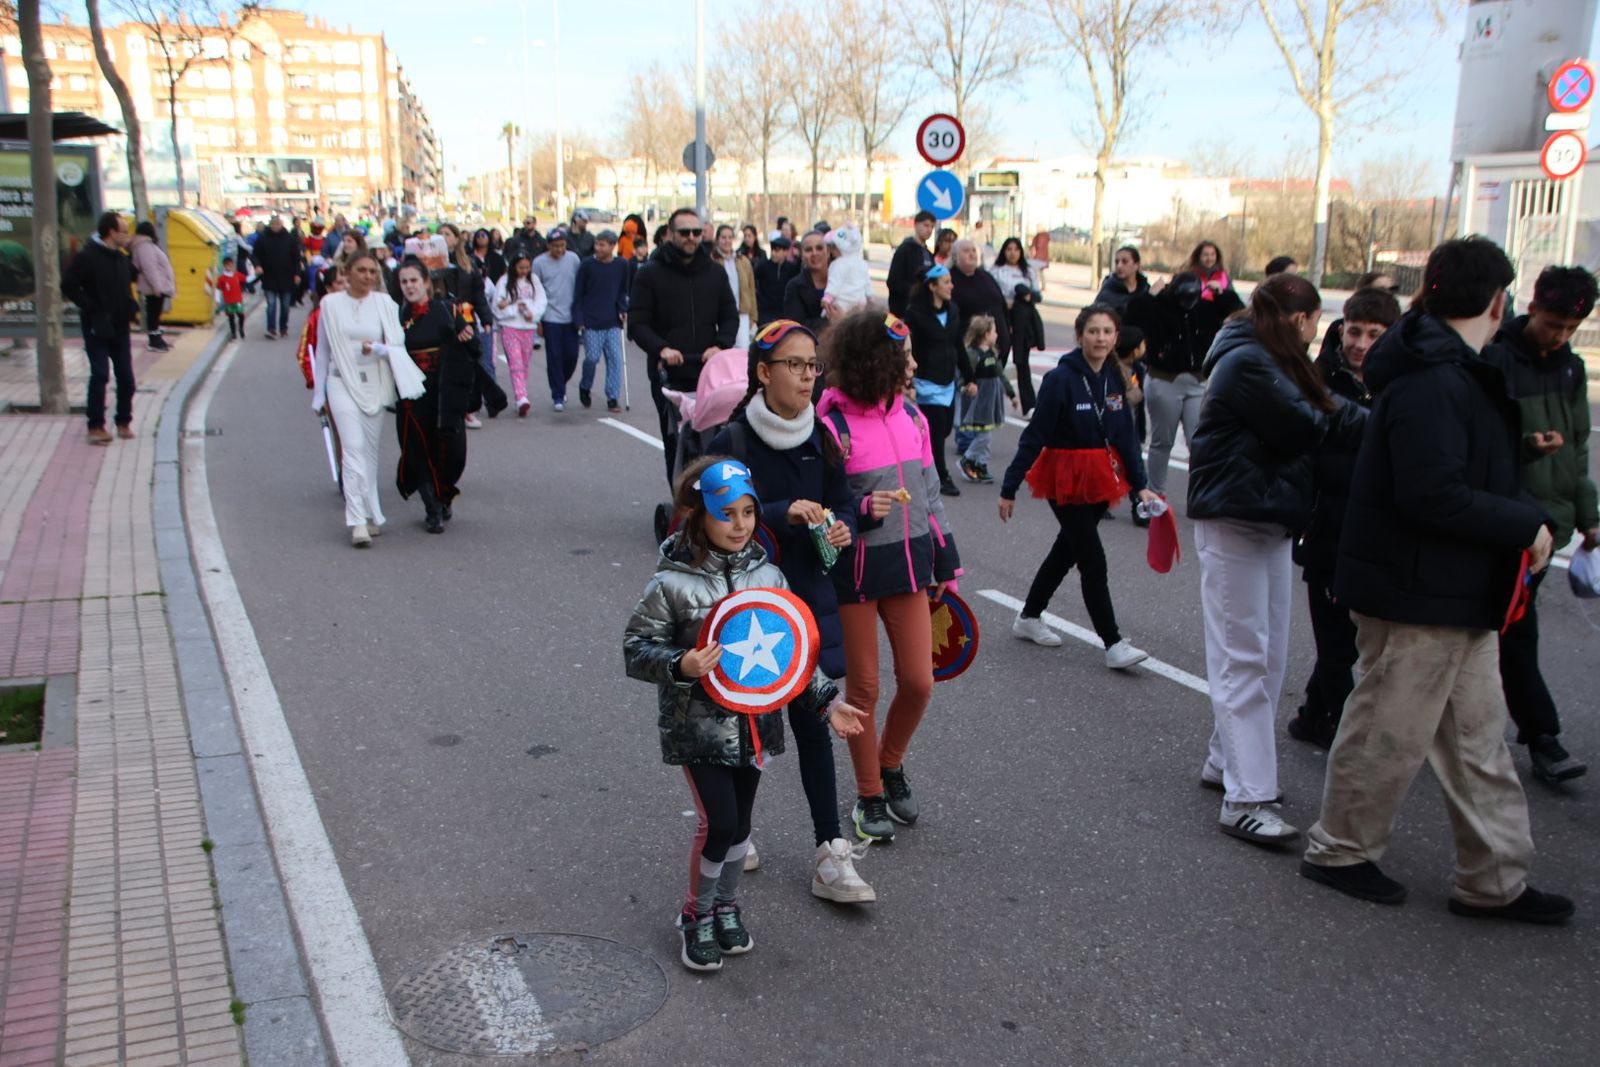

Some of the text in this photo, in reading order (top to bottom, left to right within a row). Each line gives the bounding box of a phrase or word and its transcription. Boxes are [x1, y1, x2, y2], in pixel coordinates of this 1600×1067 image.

[928, 131, 954, 149] 30
[1553, 149, 1576, 163] 30
[722, 463, 746, 481] A
